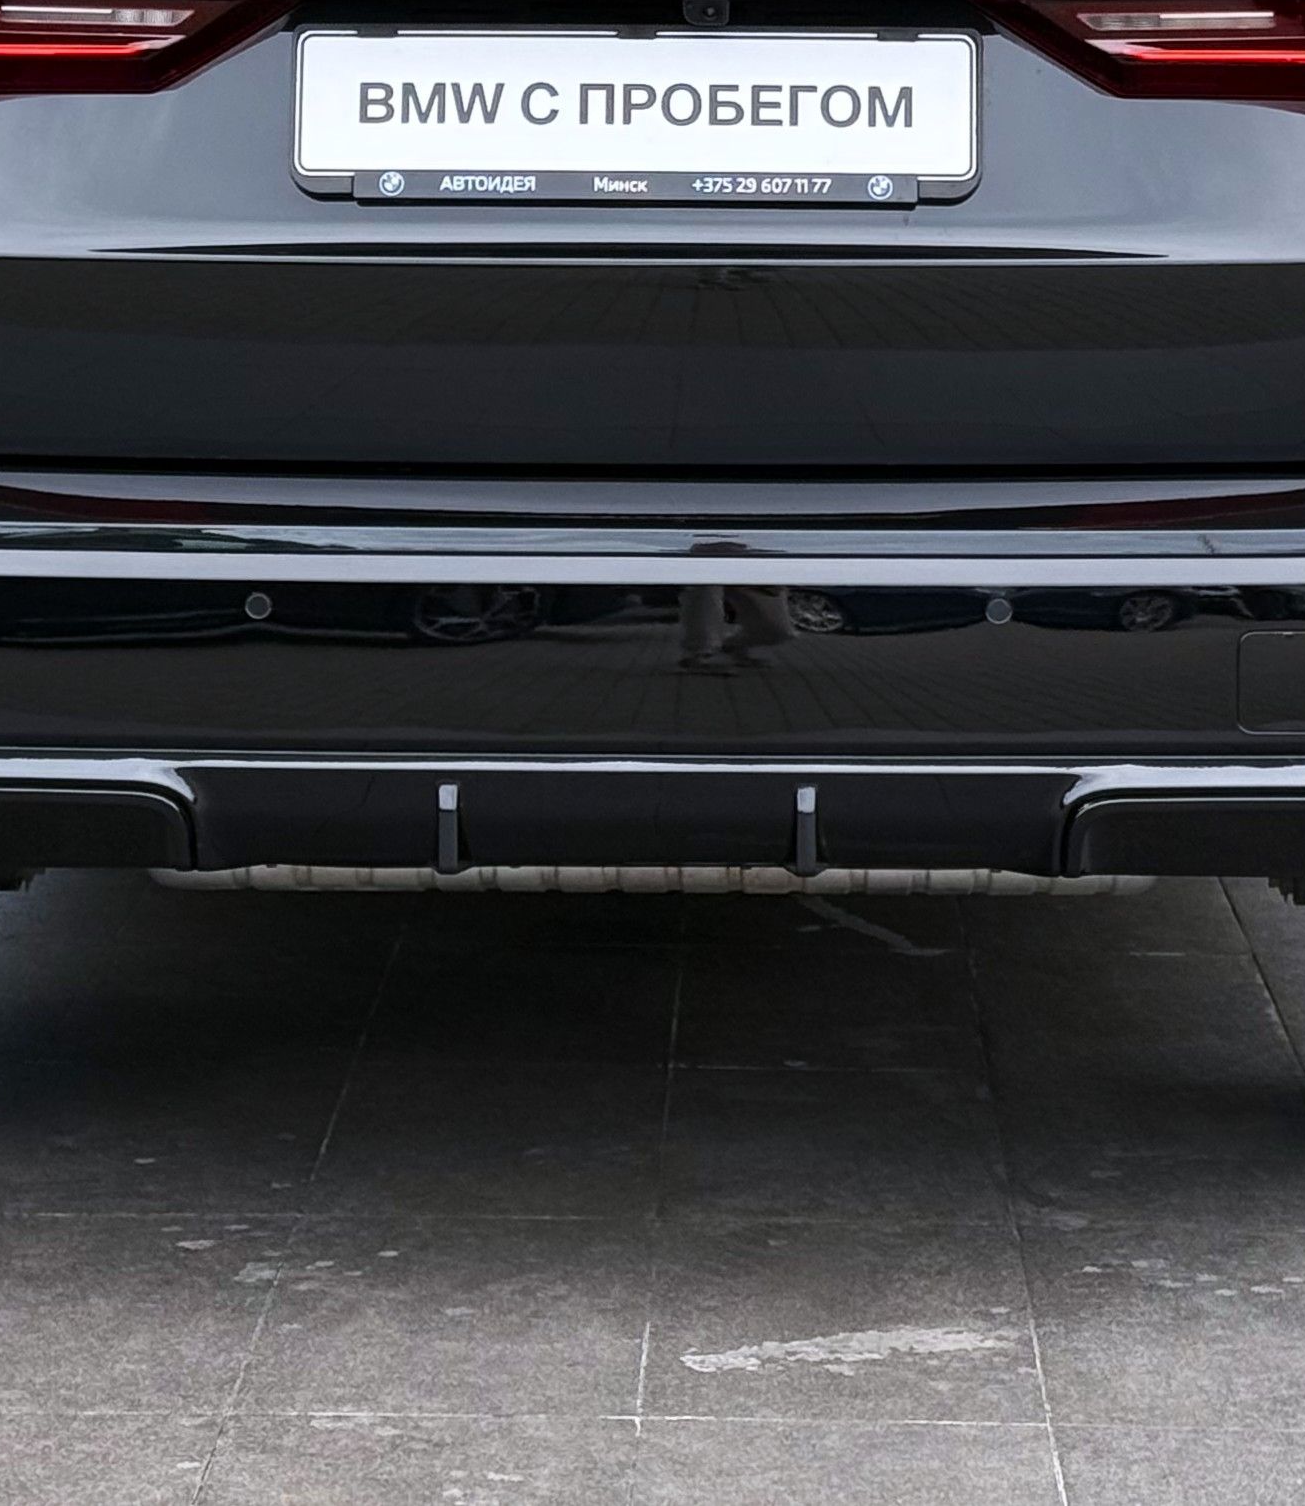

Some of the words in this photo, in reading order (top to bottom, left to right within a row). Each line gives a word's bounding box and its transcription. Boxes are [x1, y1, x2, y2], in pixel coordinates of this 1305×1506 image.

[358, 81, 505, 124] BMW
[520, 81, 560, 125] С
[578, 82, 913, 128] ПРОБЕГОМ
[439, 175, 536, 194] АВТОИДЕЯ
[593, 176, 648, 193] Минск
[692, 177, 733, 193] +375
[735, 177, 757, 193] 29
[760, 178, 793, 194] 607
[794, 178, 809, 194] 11
[811, 178, 832, 194] 77
